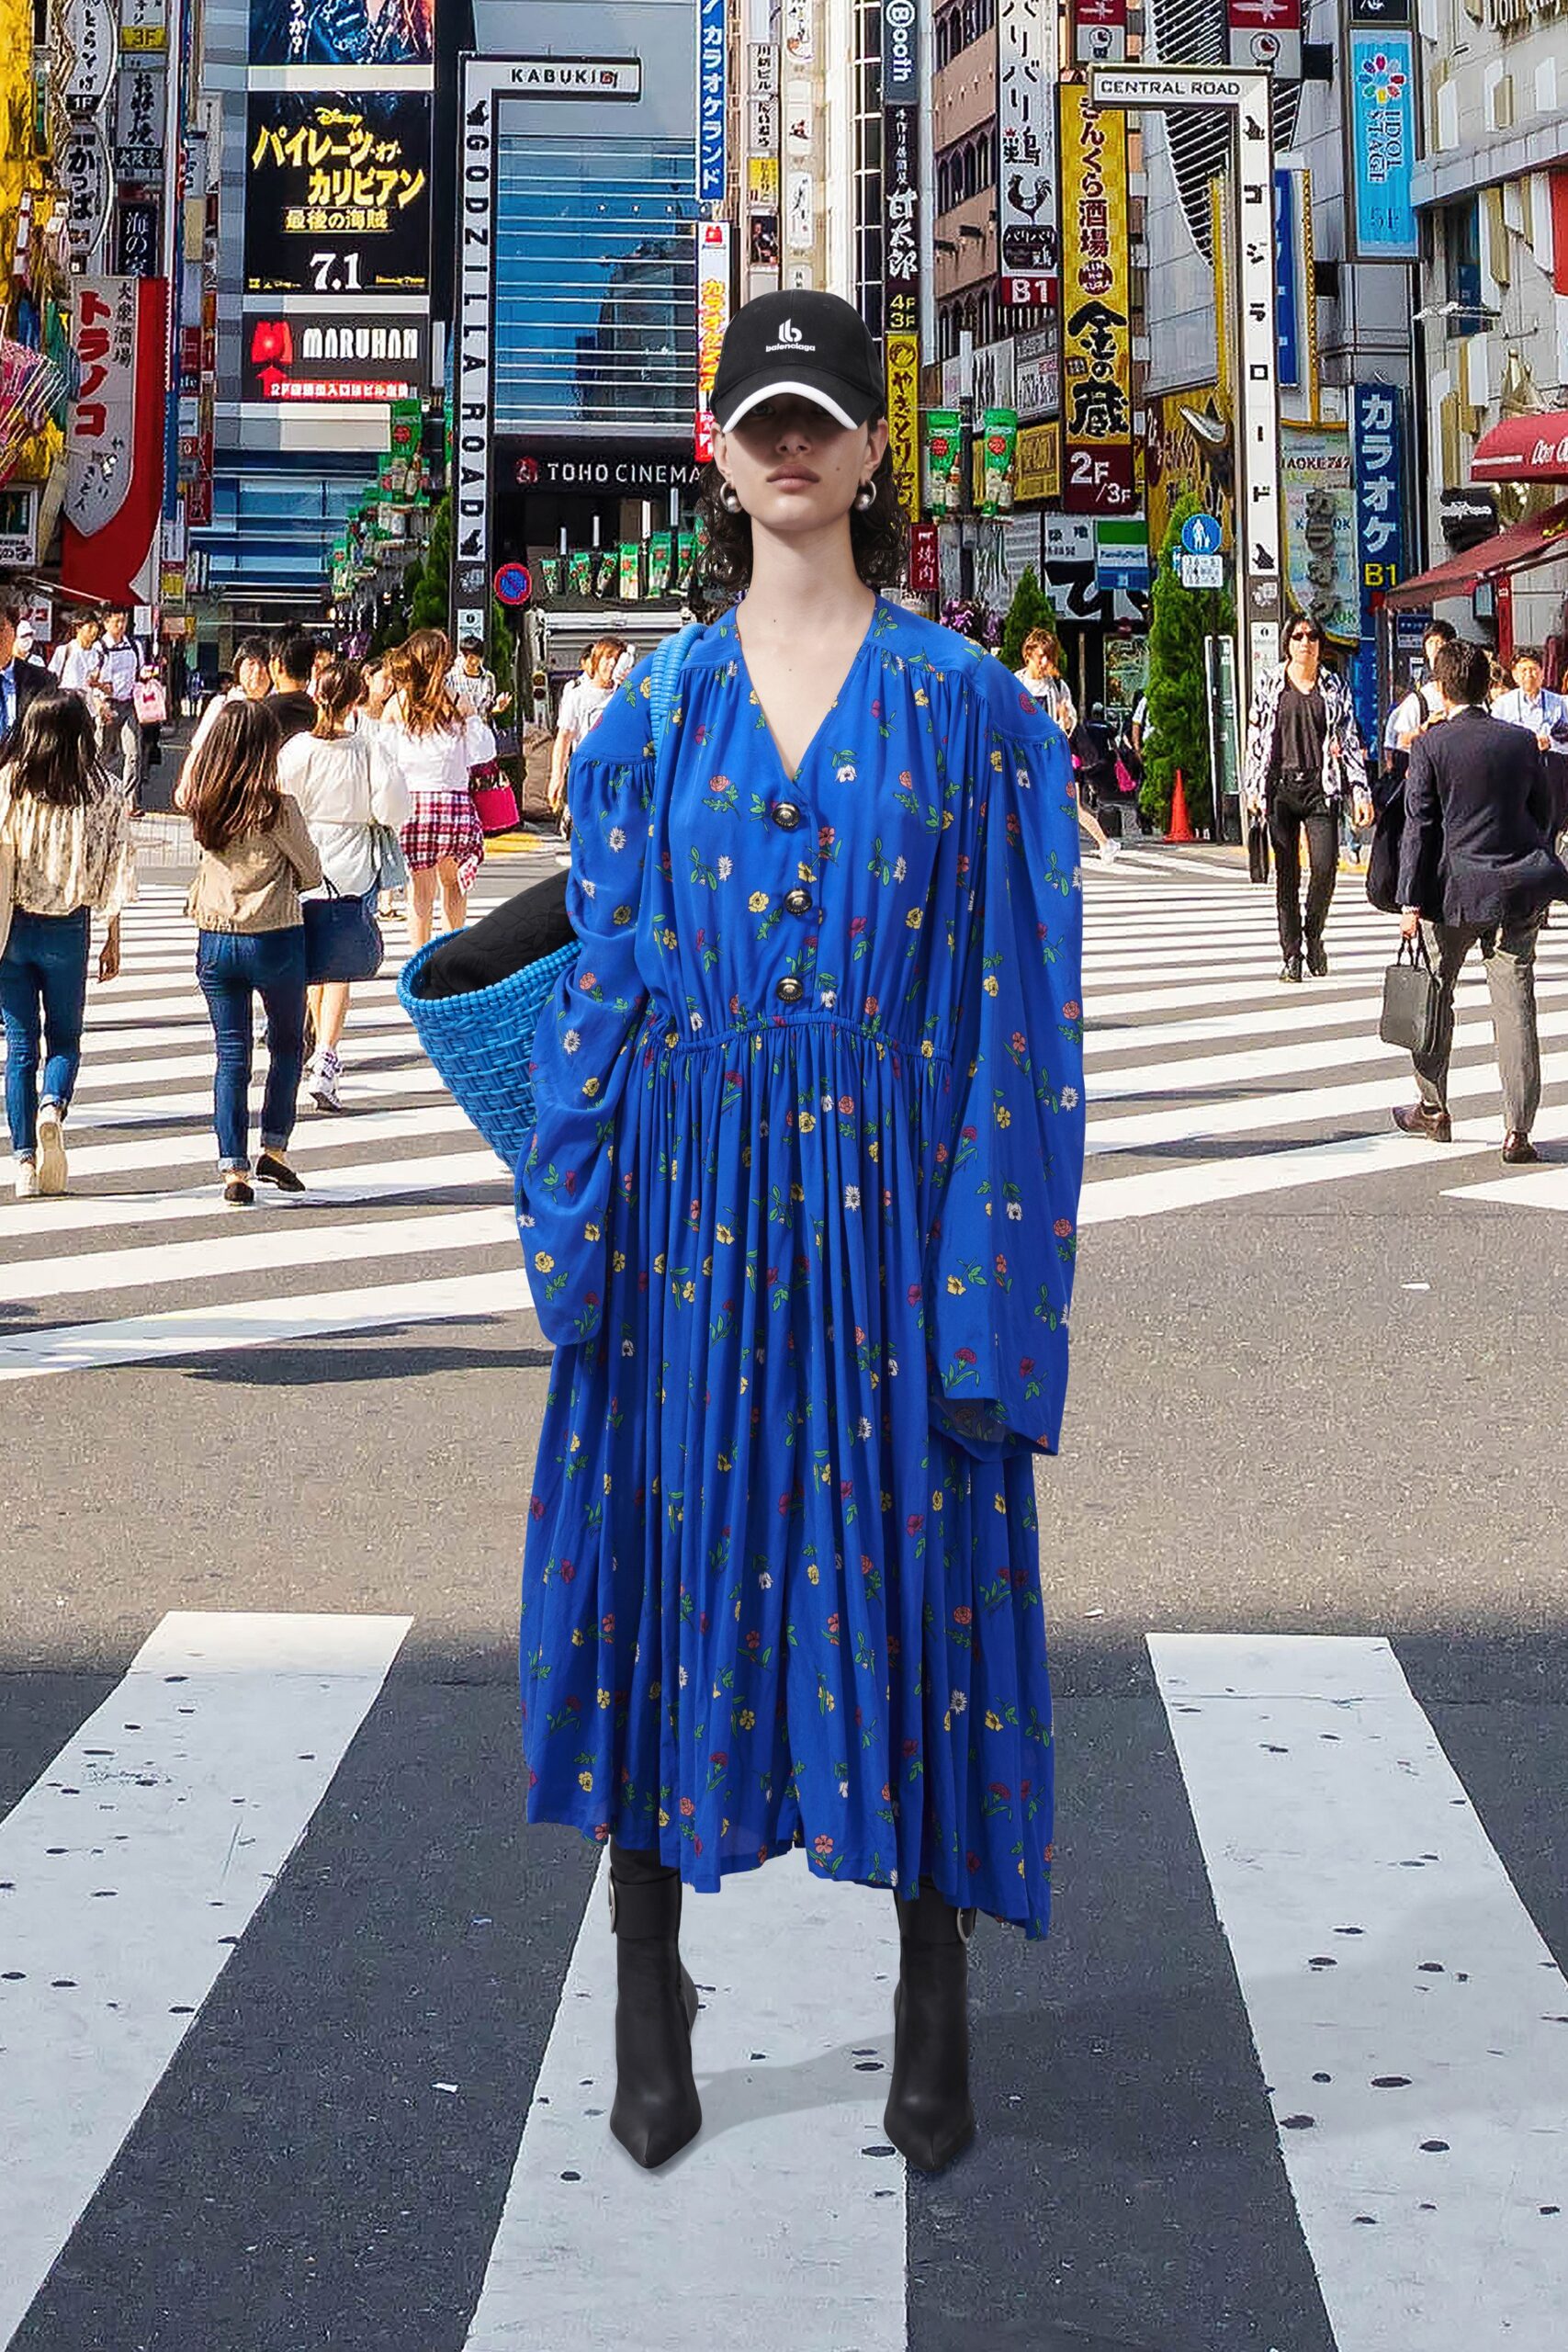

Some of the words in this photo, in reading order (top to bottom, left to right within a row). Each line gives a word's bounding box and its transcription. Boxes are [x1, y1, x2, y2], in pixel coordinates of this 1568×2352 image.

[886, 0, 915, 82] Booth
[73, 96, 93, 110] 1F
[1101, 81, 1185, 96] CENTRAL
[1191, 82, 1240, 96] ROAD
[703, 25, 723, 190] カラオケランド
[307, 167, 425, 209] カリビアン
[286, 209, 389, 231] 最後の海賊
[464, 134, 490, 372] GODZILLA
[310, 252, 362, 291] 7.1
[889, 294, 916, 311] 4F
[1011, 278, 1049, 303] B1
[890, 312, 916, 328] 3F
[302, 327, 419, 359] MARUHAN
[765, 343, 816, 353] balenciaga
[1243, 184, 1272, 503] ゴジラロード
[74, 289, 111, 438] トラノコ
[461, 402, 487, 517] ROAD
[547, 462, 609, 482] TOHO
[1361, 394, 1401, 553] カラオケ
[1363, 562, 1397, 587] B1
